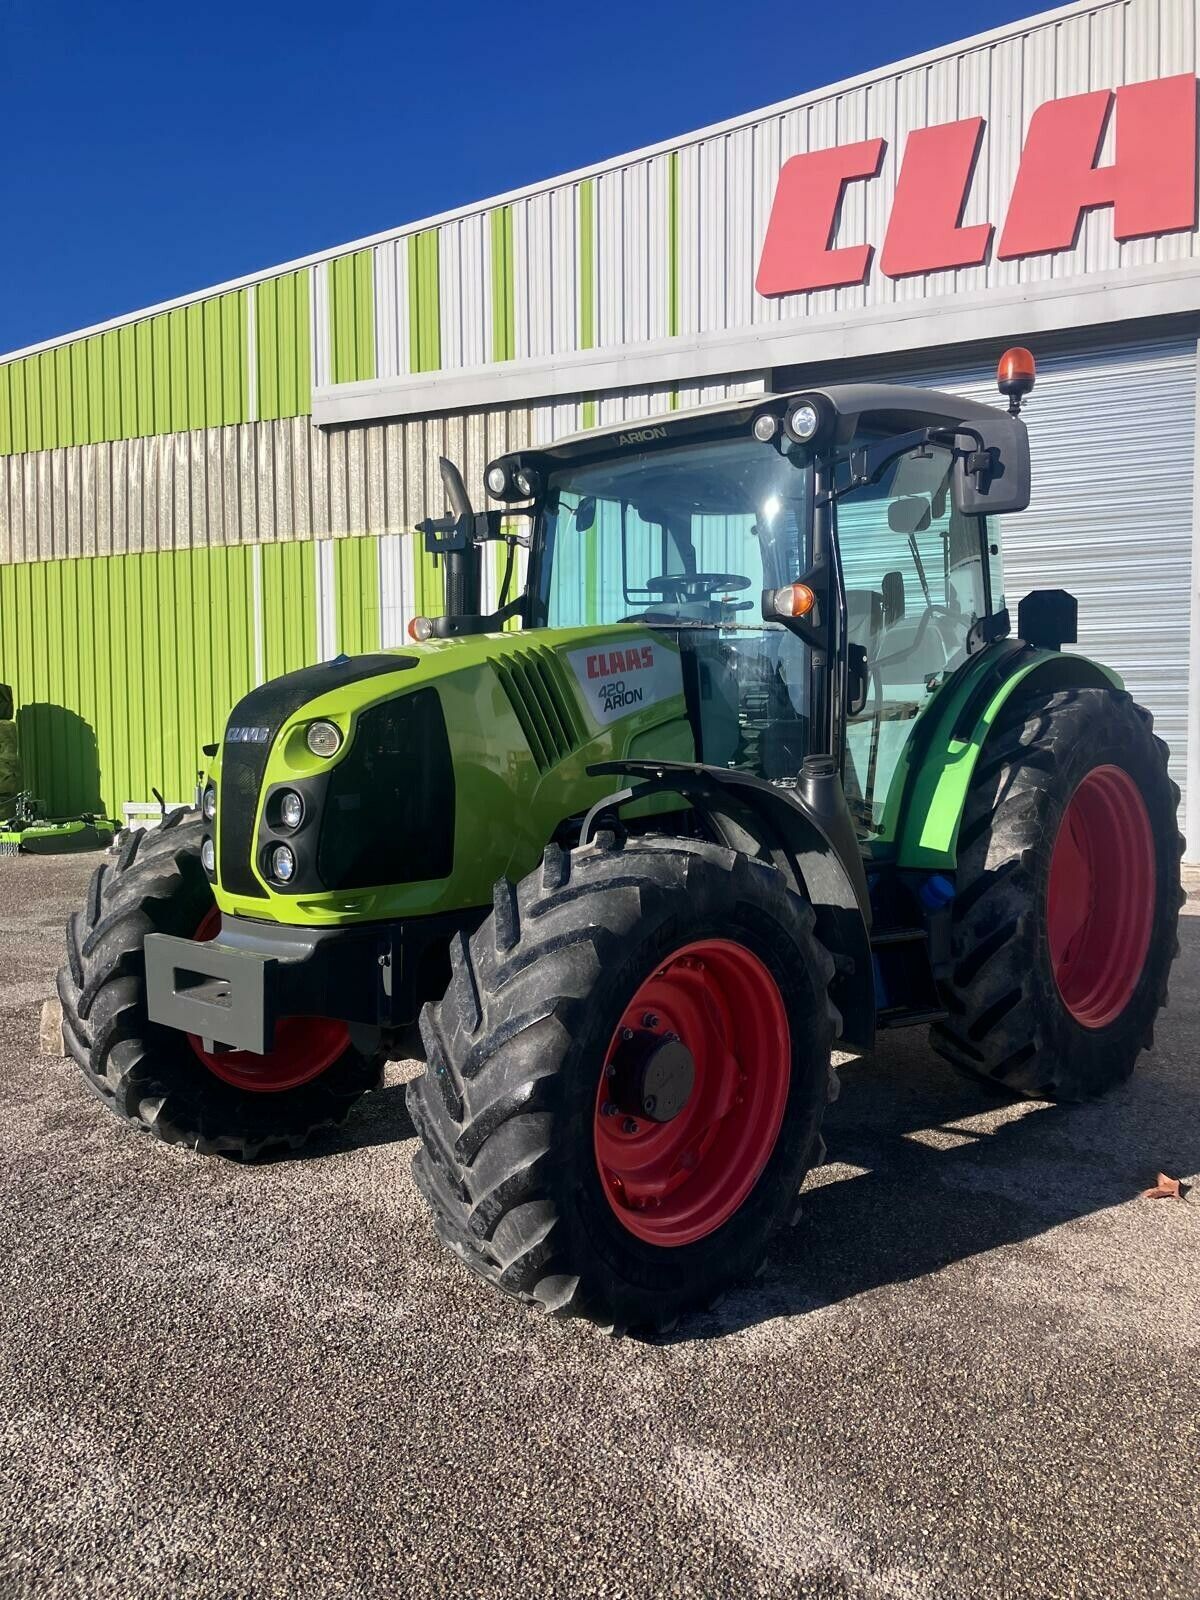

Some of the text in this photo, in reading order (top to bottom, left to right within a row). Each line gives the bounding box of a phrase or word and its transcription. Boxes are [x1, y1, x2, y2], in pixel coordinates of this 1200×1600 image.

[755, 72, 1197, 299] CLA
[619, 426, 667, 446] ARION
[586, 646, 654, 679] CLAAS
[598, 681, 626, 699] 420
[603, 687, 643, 713] ARION
